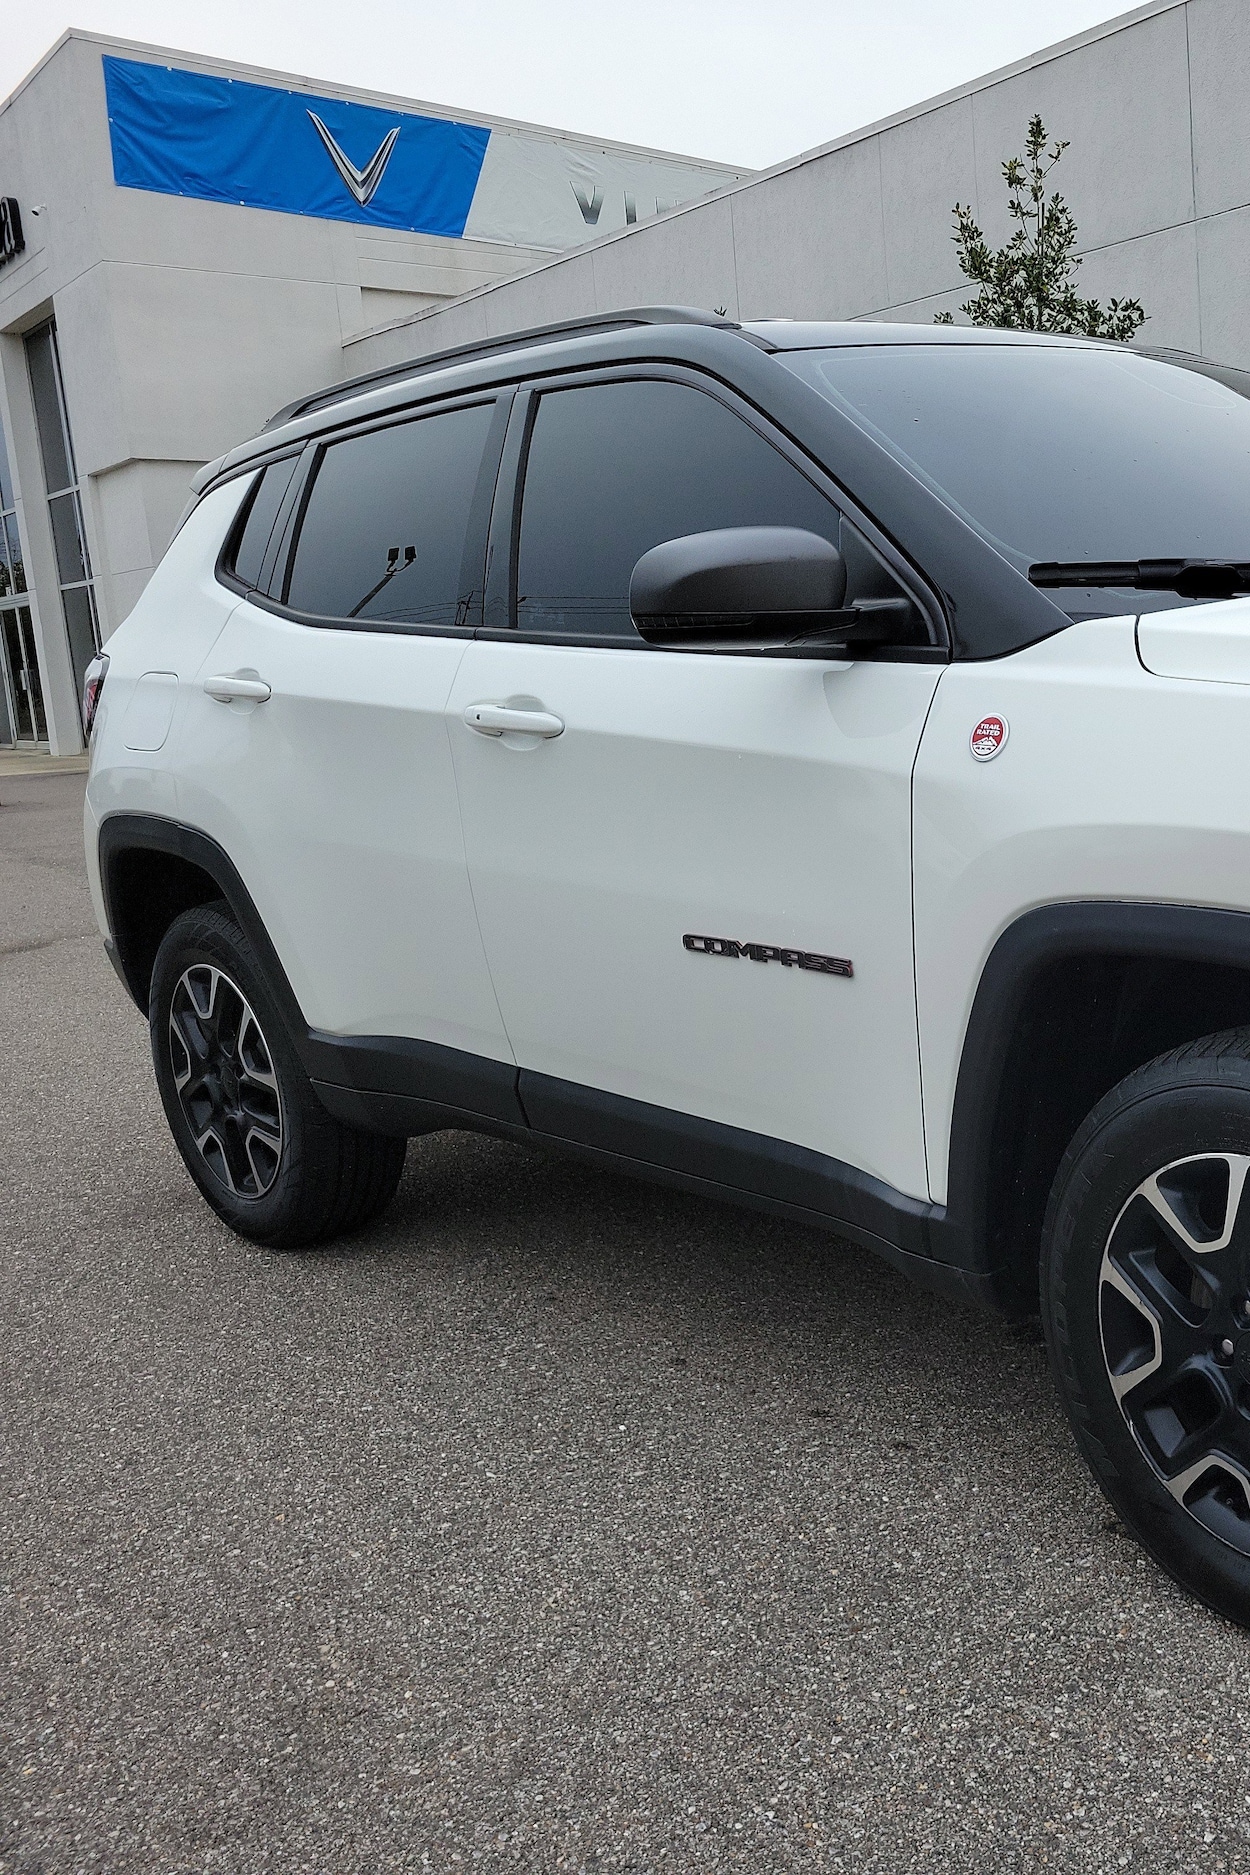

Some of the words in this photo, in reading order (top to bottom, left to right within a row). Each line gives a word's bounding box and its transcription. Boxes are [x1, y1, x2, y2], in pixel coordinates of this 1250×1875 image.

[980, 723, 1001, 731] TRAIL
[976, 728, 1001, 737] RATED
[682, 933, 853, 978] COMPASS
